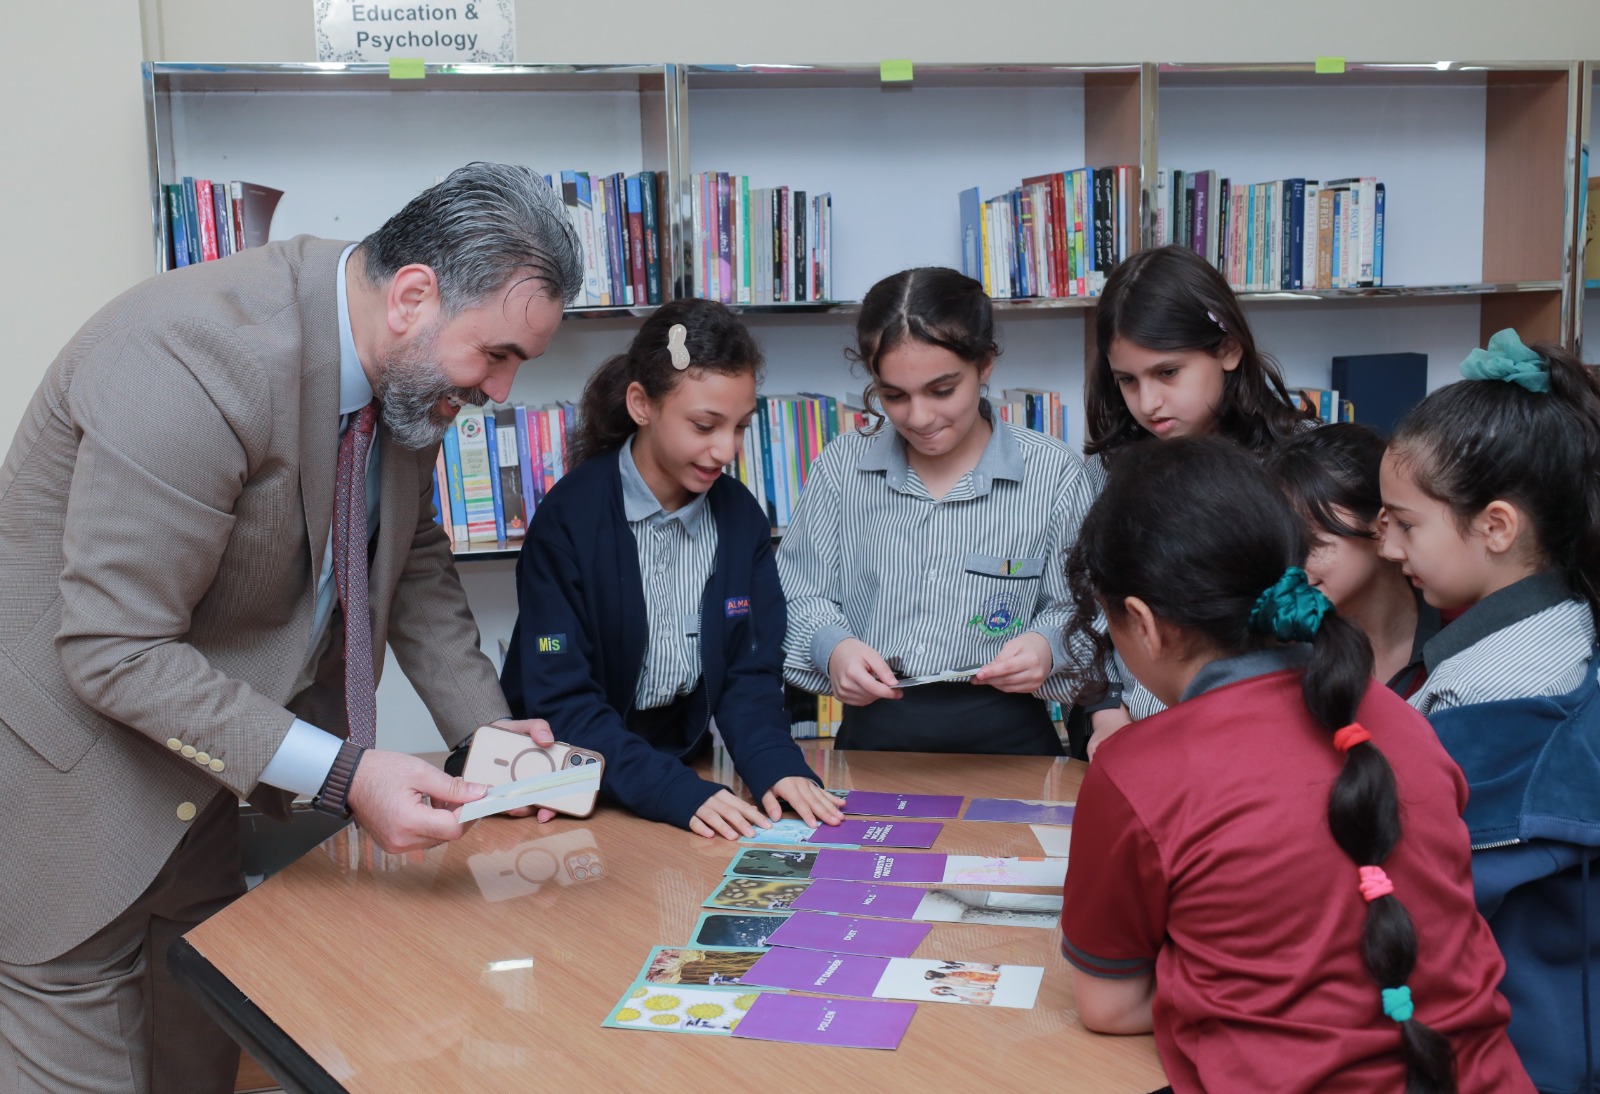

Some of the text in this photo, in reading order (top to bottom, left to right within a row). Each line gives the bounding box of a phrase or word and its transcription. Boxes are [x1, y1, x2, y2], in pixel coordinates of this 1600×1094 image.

[352, 3, 479, 21] Education &
[356, 31, 478, 51] Psychology
[1320, 197, 1329, 230] AFRICA
[1350, 208, 1359, 240] ROME
[873, 855, 887, 879] COMBUSTION
[843, 929, 858, 941] DUST
[814, 976, 828, 986] PET
[817, 1010, 836, 1031] POLLEN
